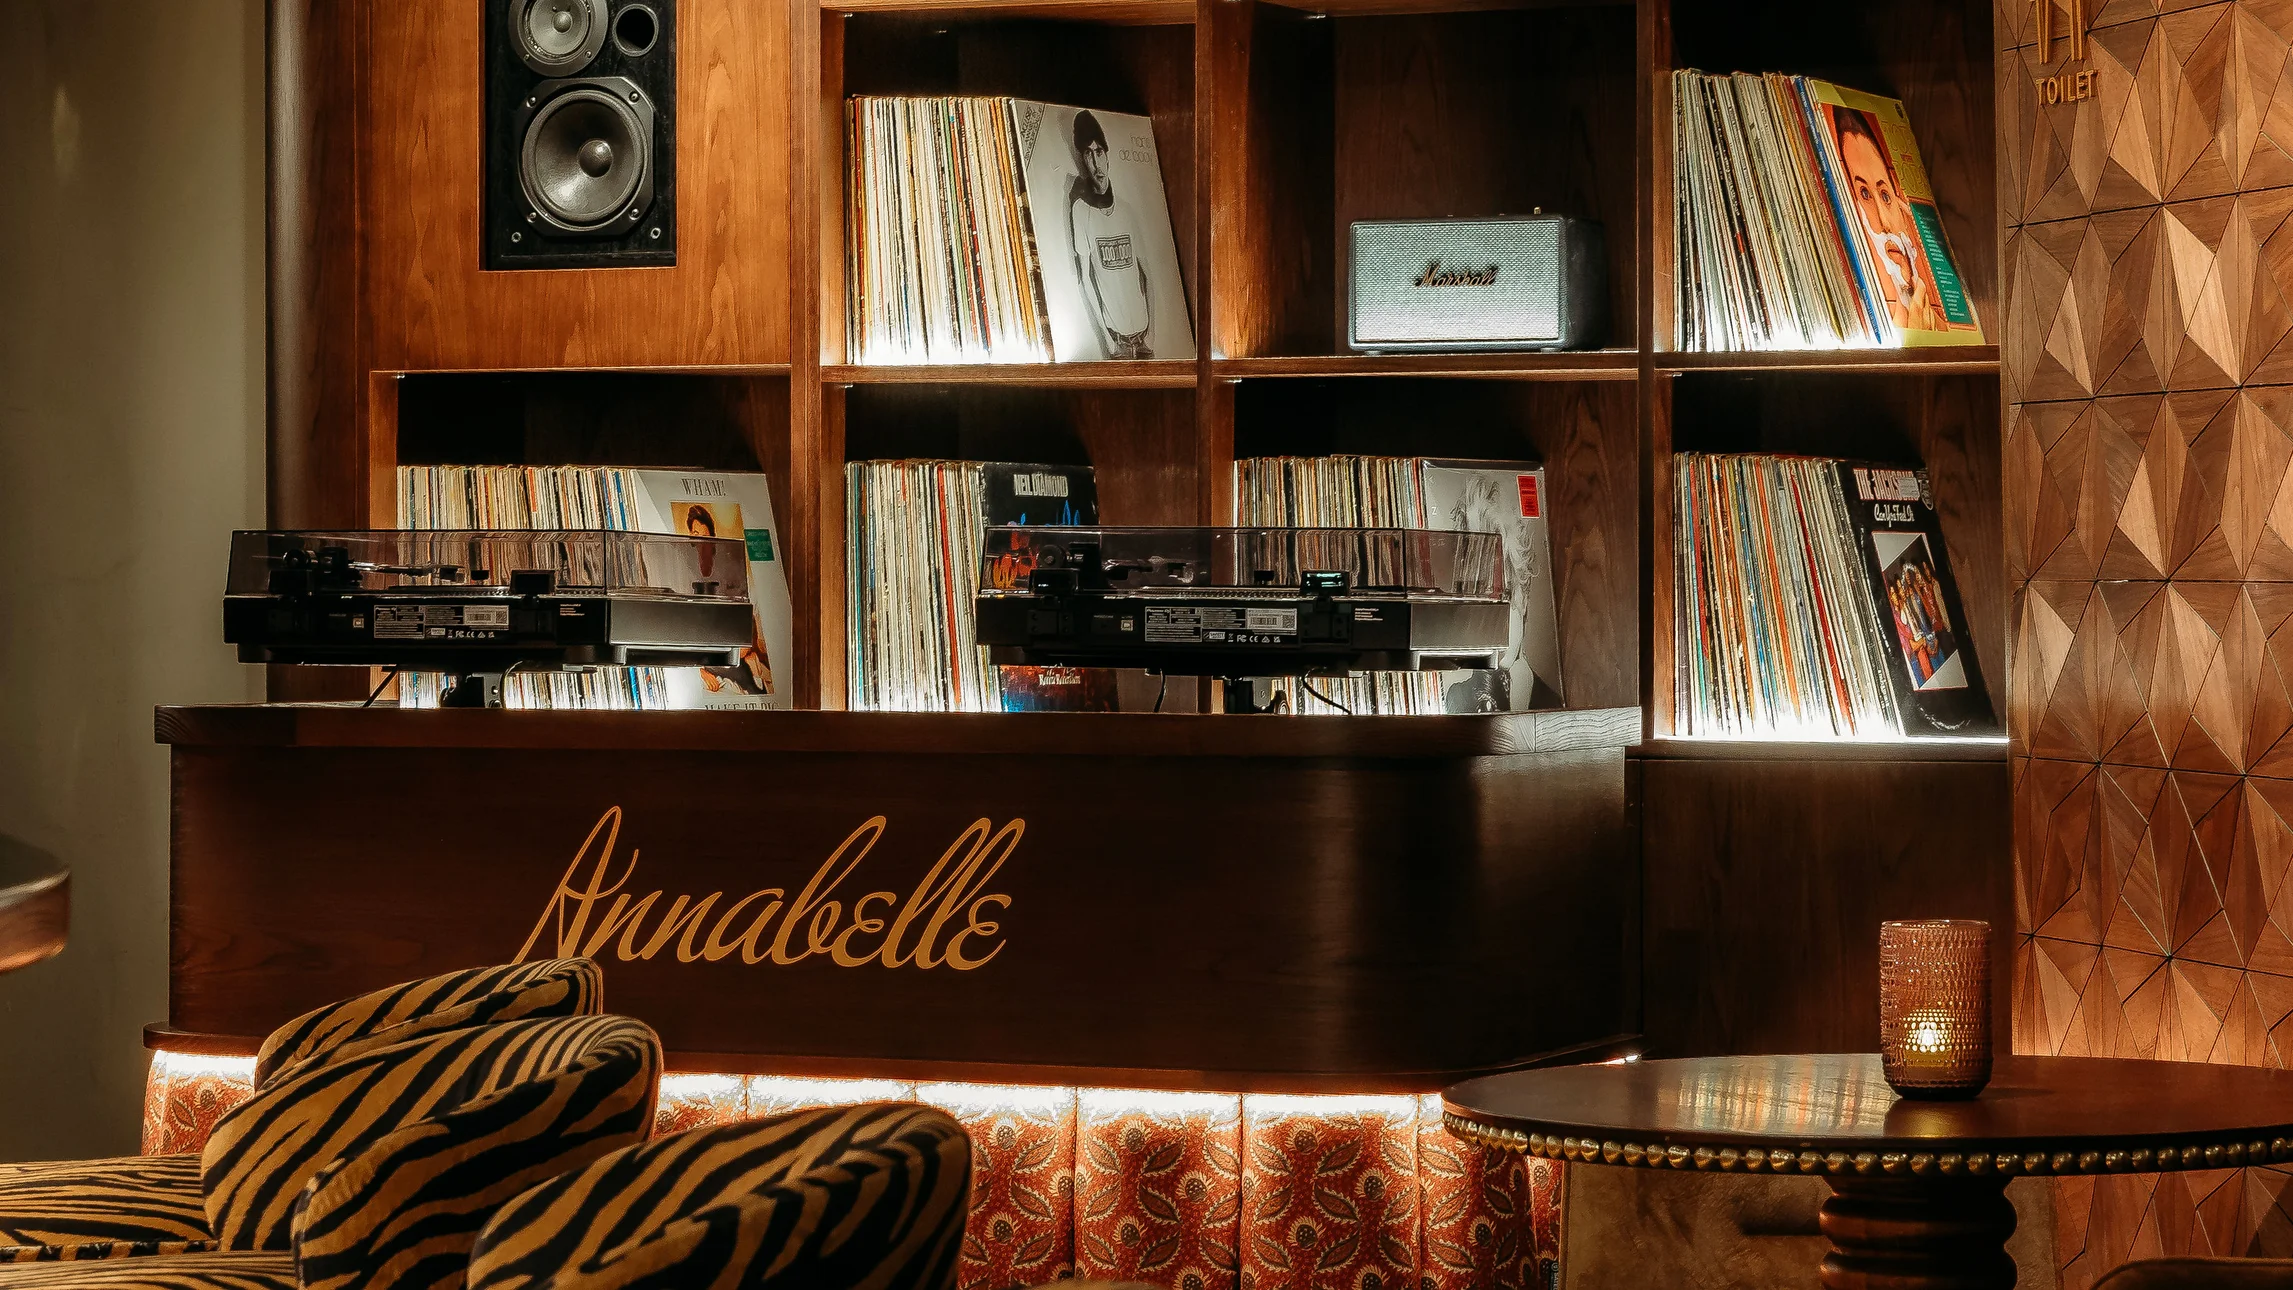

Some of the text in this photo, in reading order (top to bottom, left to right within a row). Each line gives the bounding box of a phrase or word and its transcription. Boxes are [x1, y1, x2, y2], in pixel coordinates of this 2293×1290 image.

[2035, 69, 2095, 106] TOILET
[1415, 264, 1498, 288] Marshall
[681, 478, 727, 496] WHAM!
[1013, 471, 1069, 497] NEIL DIAMOND
[1853, 468, 1875, 500] THE
[511, 805, 1026, 971] Annabelle
